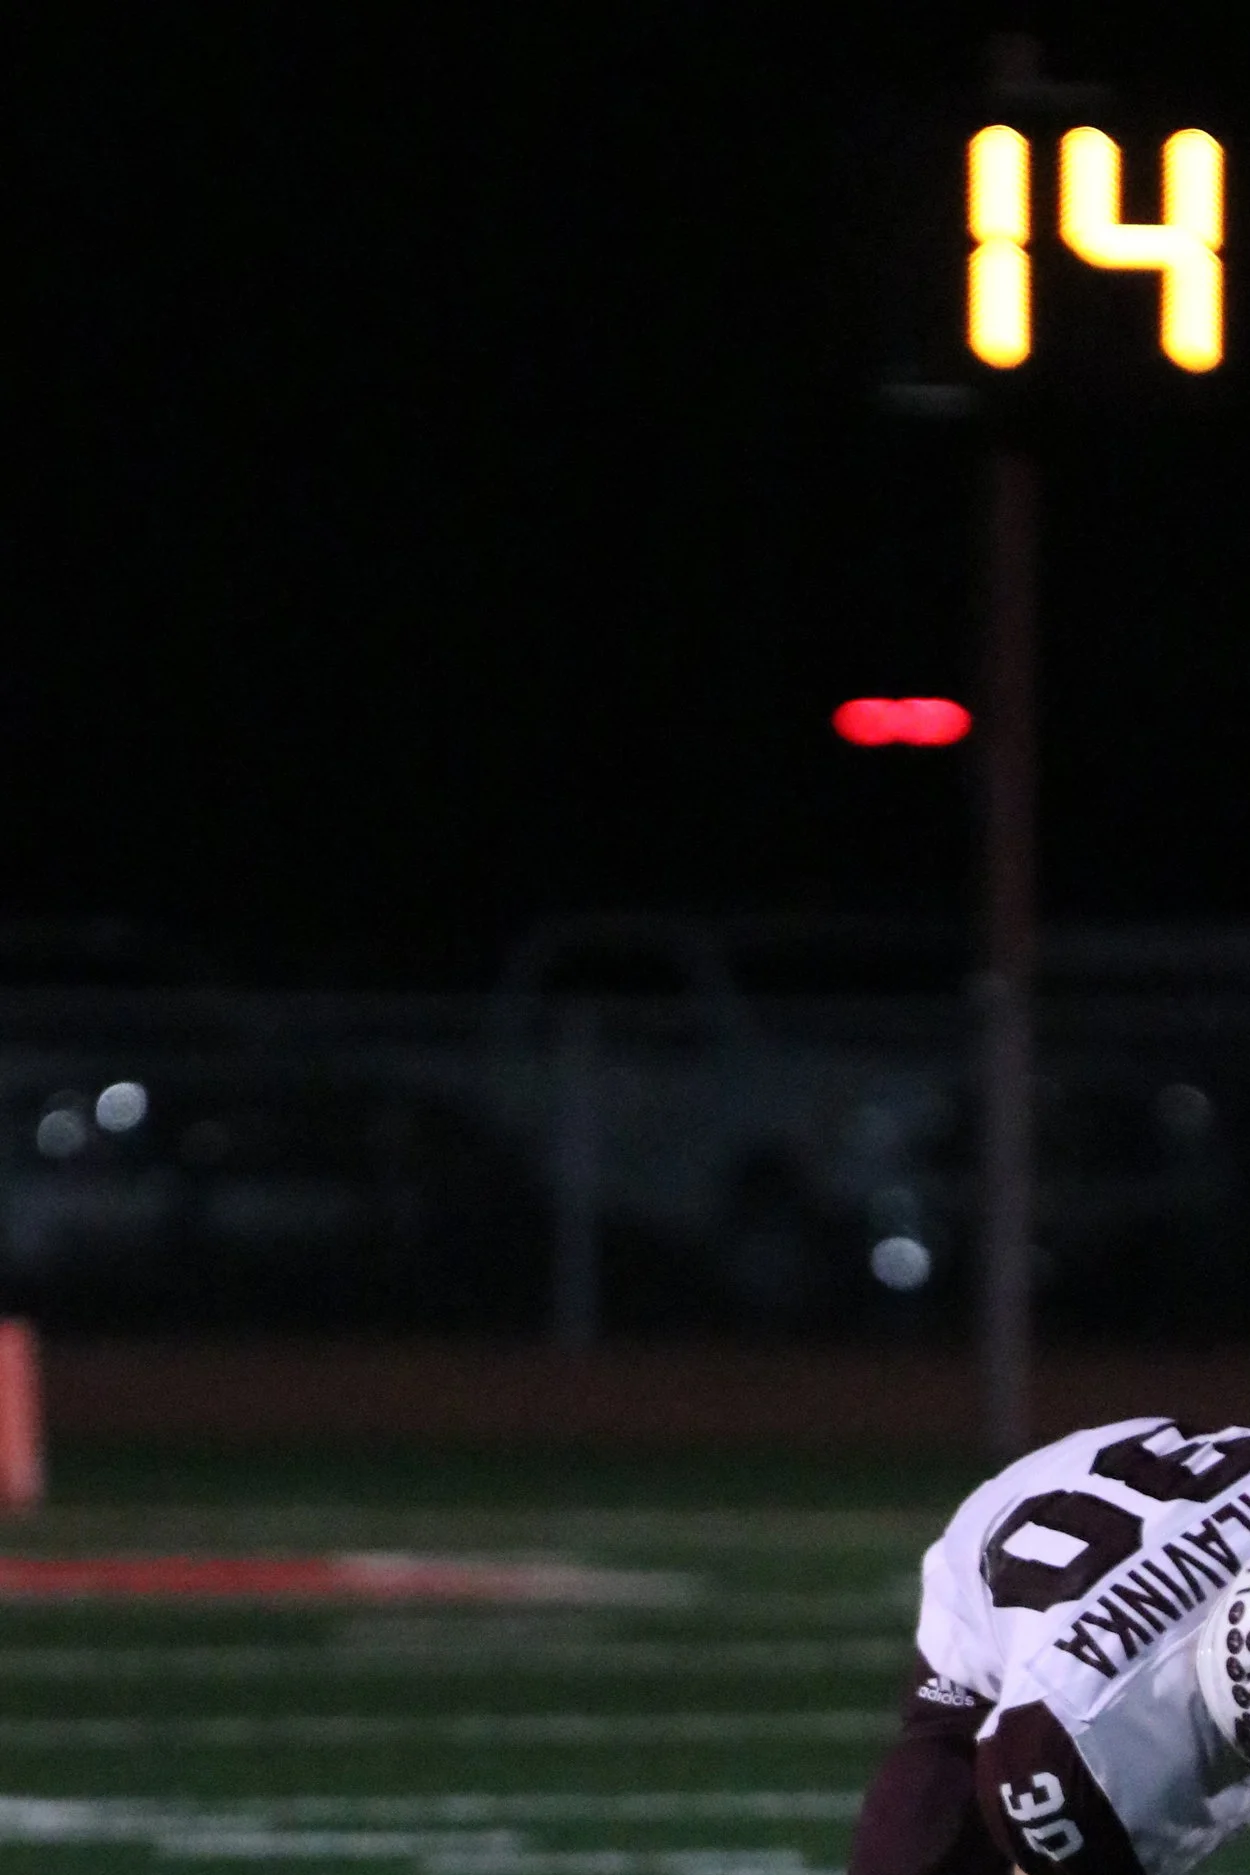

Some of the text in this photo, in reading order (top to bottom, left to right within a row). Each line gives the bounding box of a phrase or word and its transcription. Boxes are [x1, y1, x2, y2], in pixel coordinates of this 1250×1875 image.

[967, 124, 1226, 373] 14
[918, 1683, 975, 1707] adidas
[1000, 1771, 1084, 1862] 30
